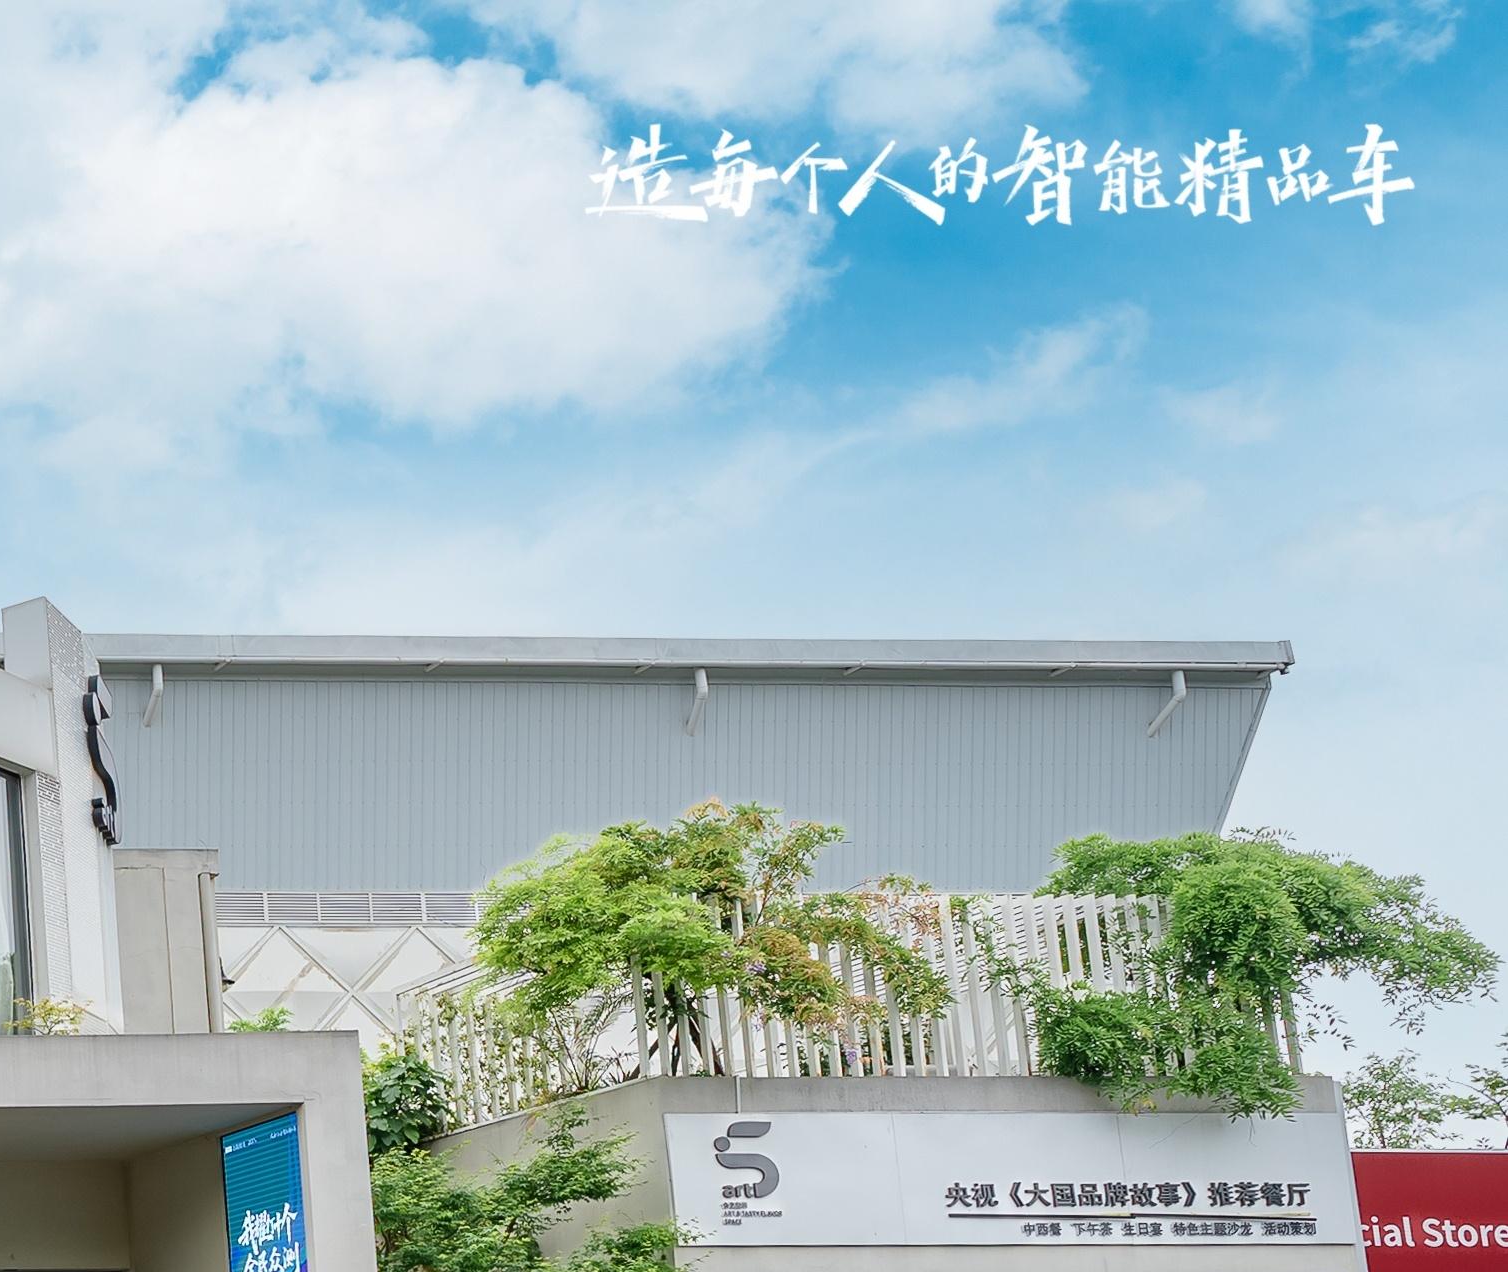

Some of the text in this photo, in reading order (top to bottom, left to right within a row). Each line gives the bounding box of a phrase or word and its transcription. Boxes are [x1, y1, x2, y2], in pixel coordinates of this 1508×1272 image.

[945, 1182, 1310, 1208] 央视《大国品牌故事》推荐餐厅
[1021, 1222, 1062, 1236] 中西餐
[1262, 1222, 1317, 1236] 活动策划
[1421, 1217, 1508, 1248] Store
